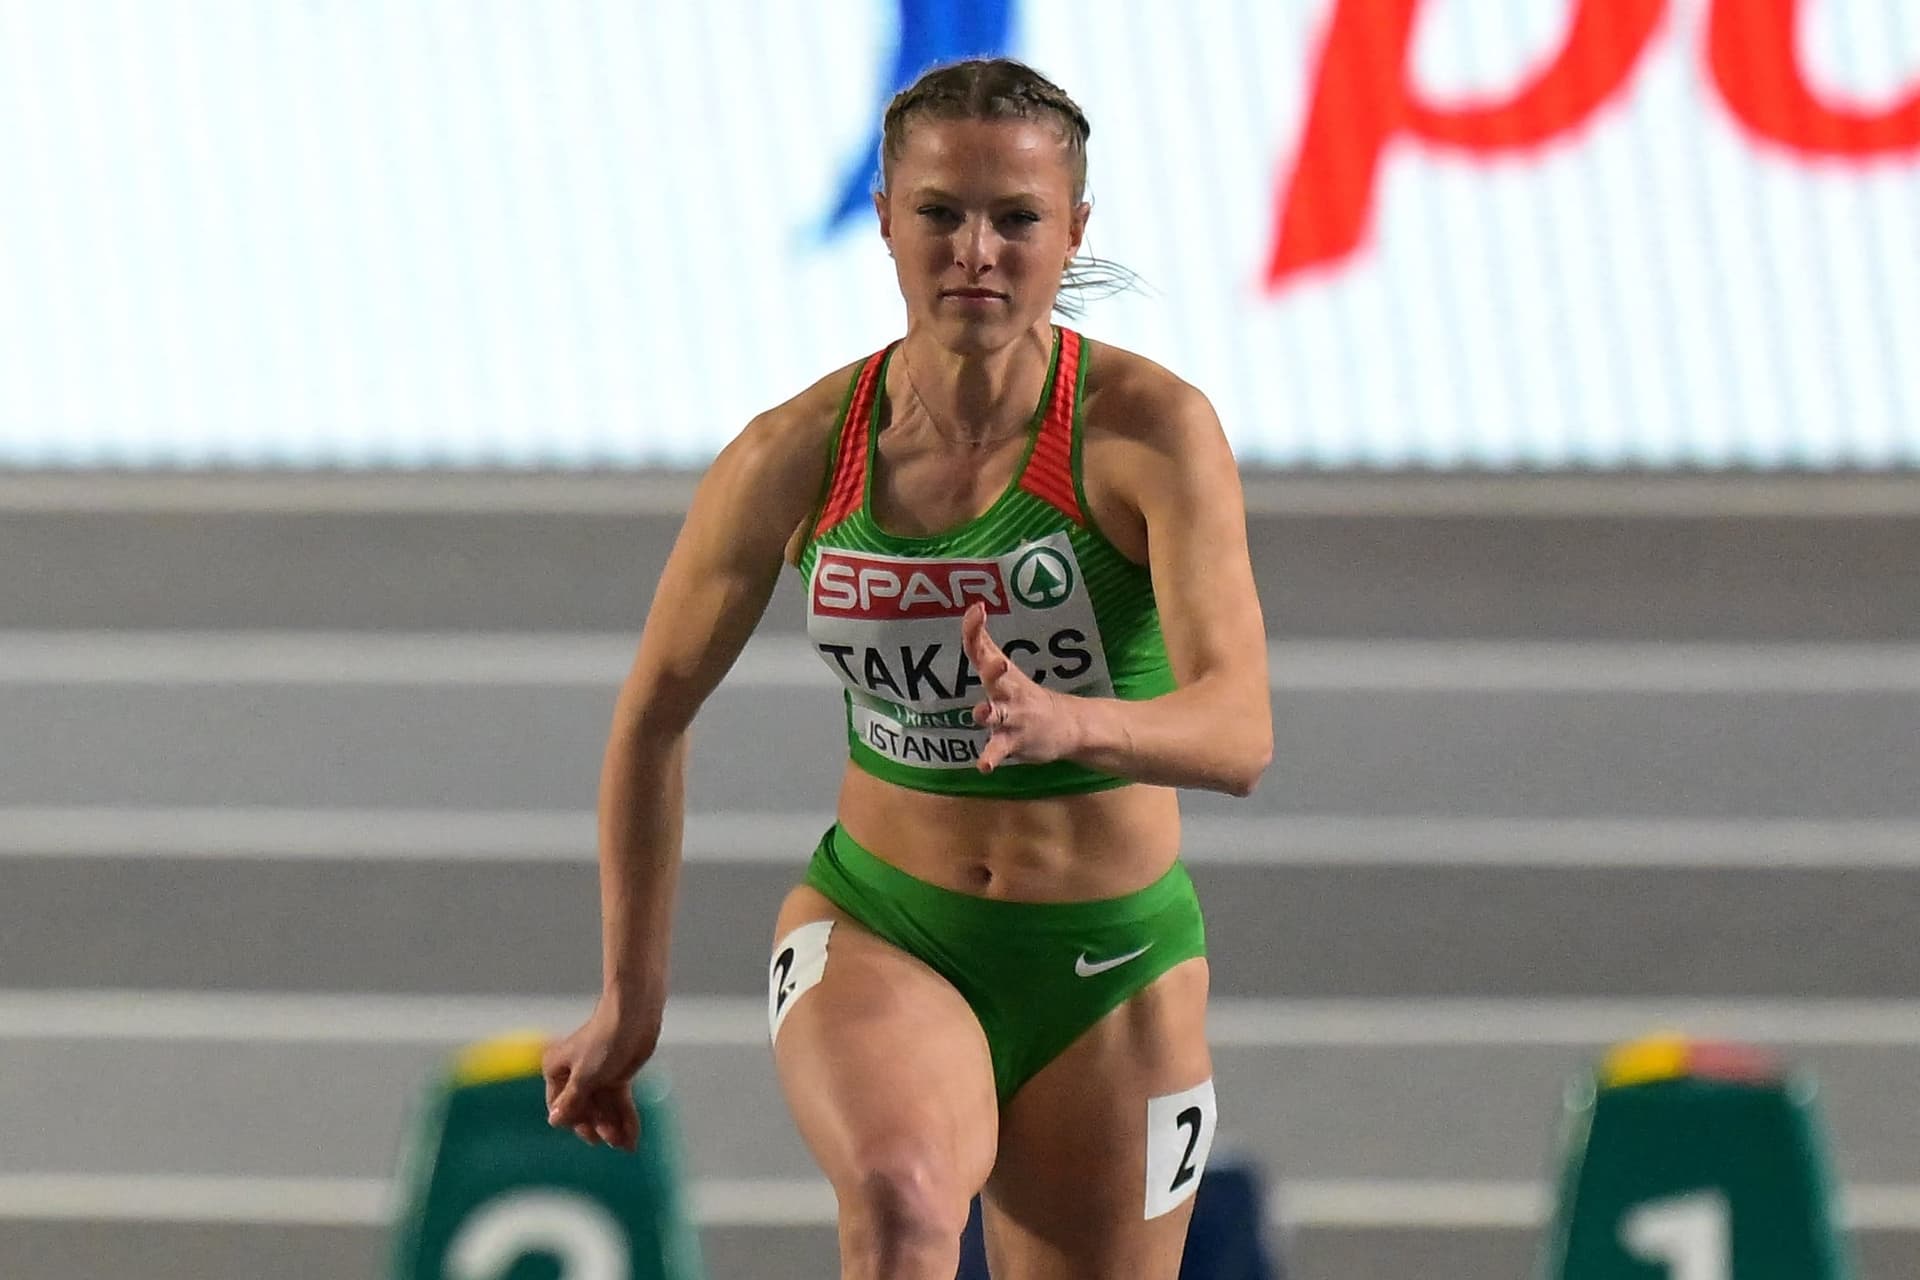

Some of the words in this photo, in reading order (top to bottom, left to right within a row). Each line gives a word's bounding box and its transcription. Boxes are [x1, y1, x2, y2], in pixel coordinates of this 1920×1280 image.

[817, 563, 1000, 611] SPAR
[869, 720, 980, 763] ISTANB
[773, 947, 797, 1017] 2
[1169, 1106, 1202, 1193] 2
